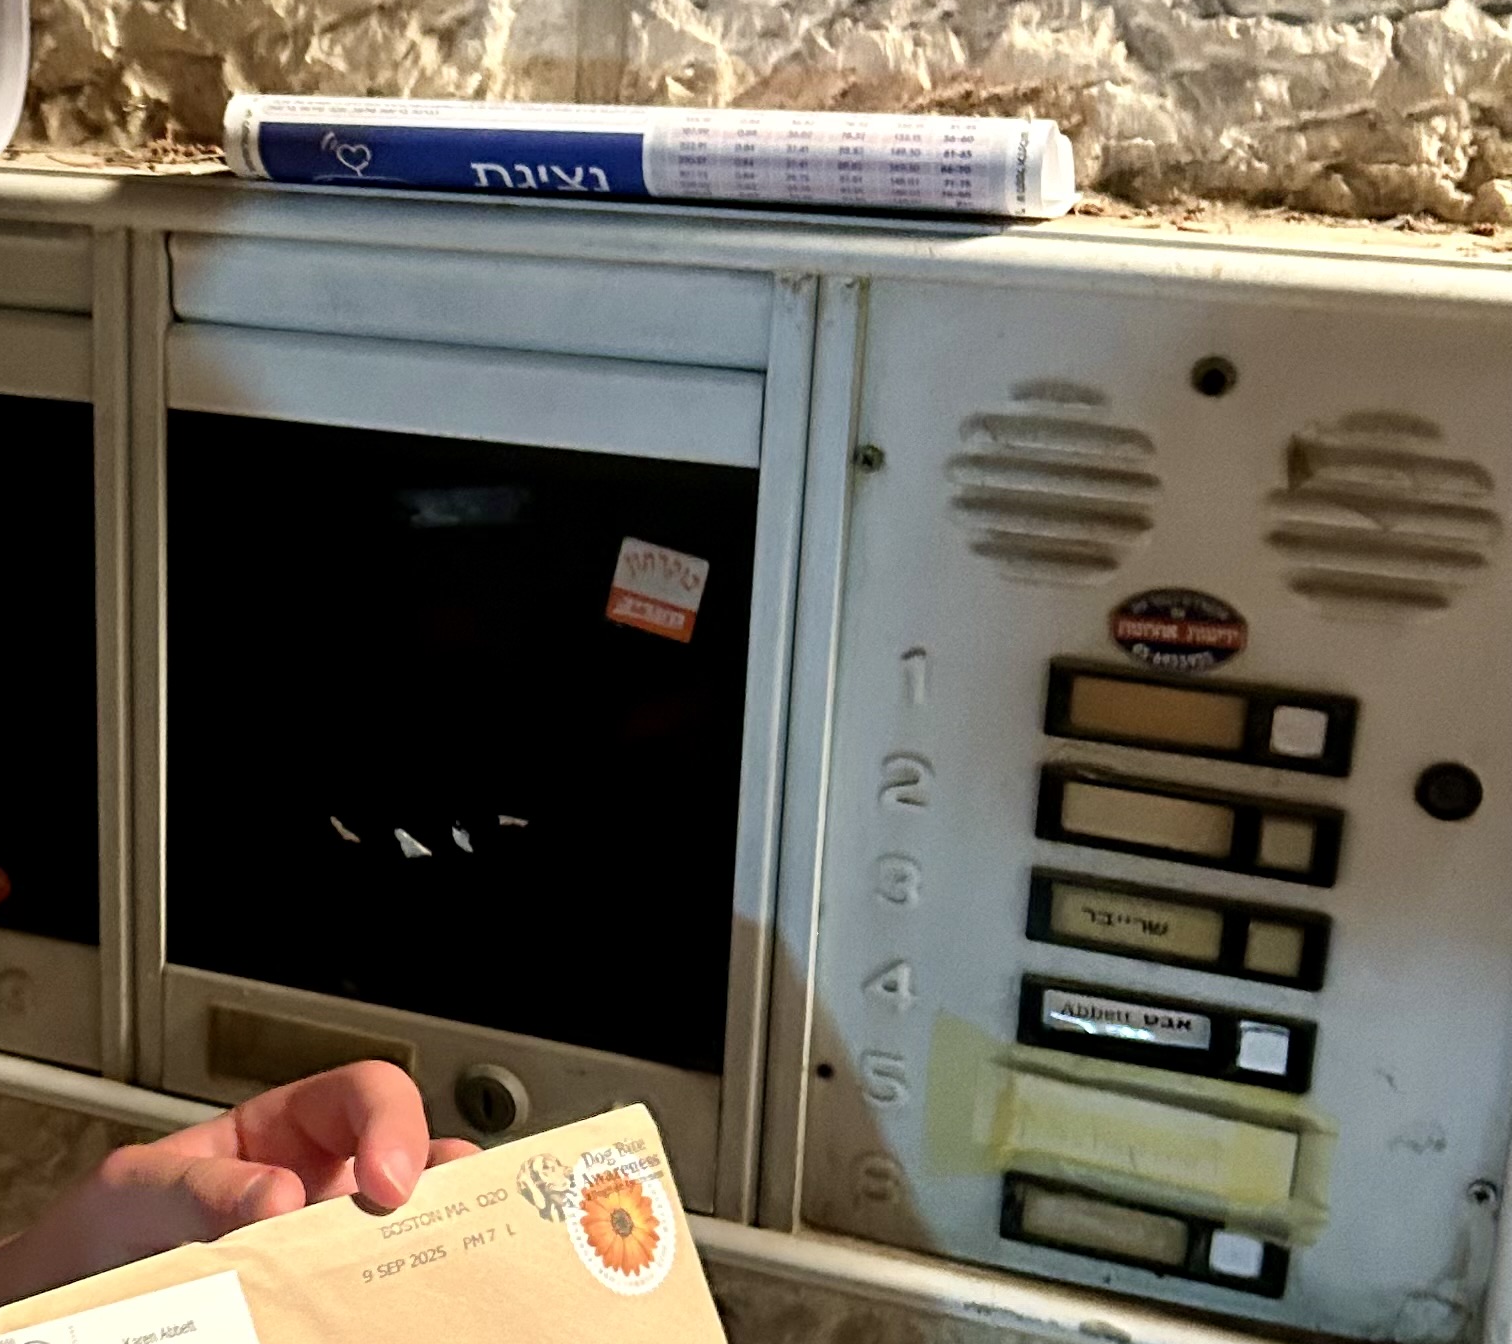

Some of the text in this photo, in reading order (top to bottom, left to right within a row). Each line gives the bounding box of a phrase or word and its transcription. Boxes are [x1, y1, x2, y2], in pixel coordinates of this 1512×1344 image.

[899, 644, 929, 708] 1
[876, 750, 936, 811] 2
[860, 957, 920, 1010] 4
[580, 1147, 617, 1169] Dog
[582, 1153, 661, 1189] Awareness
[379, 1209, 444, 1240] BOSTON
[445, 1201, 471, 1219] MA
[362, 1268, 374, 1284] 9
[376, 1257, 407, 1279] SEP
[409, 1244, 448, 1269] 2025
[462, 1232, 486, 1250] PM
[160, 1319, 198, 1341] Abbett
